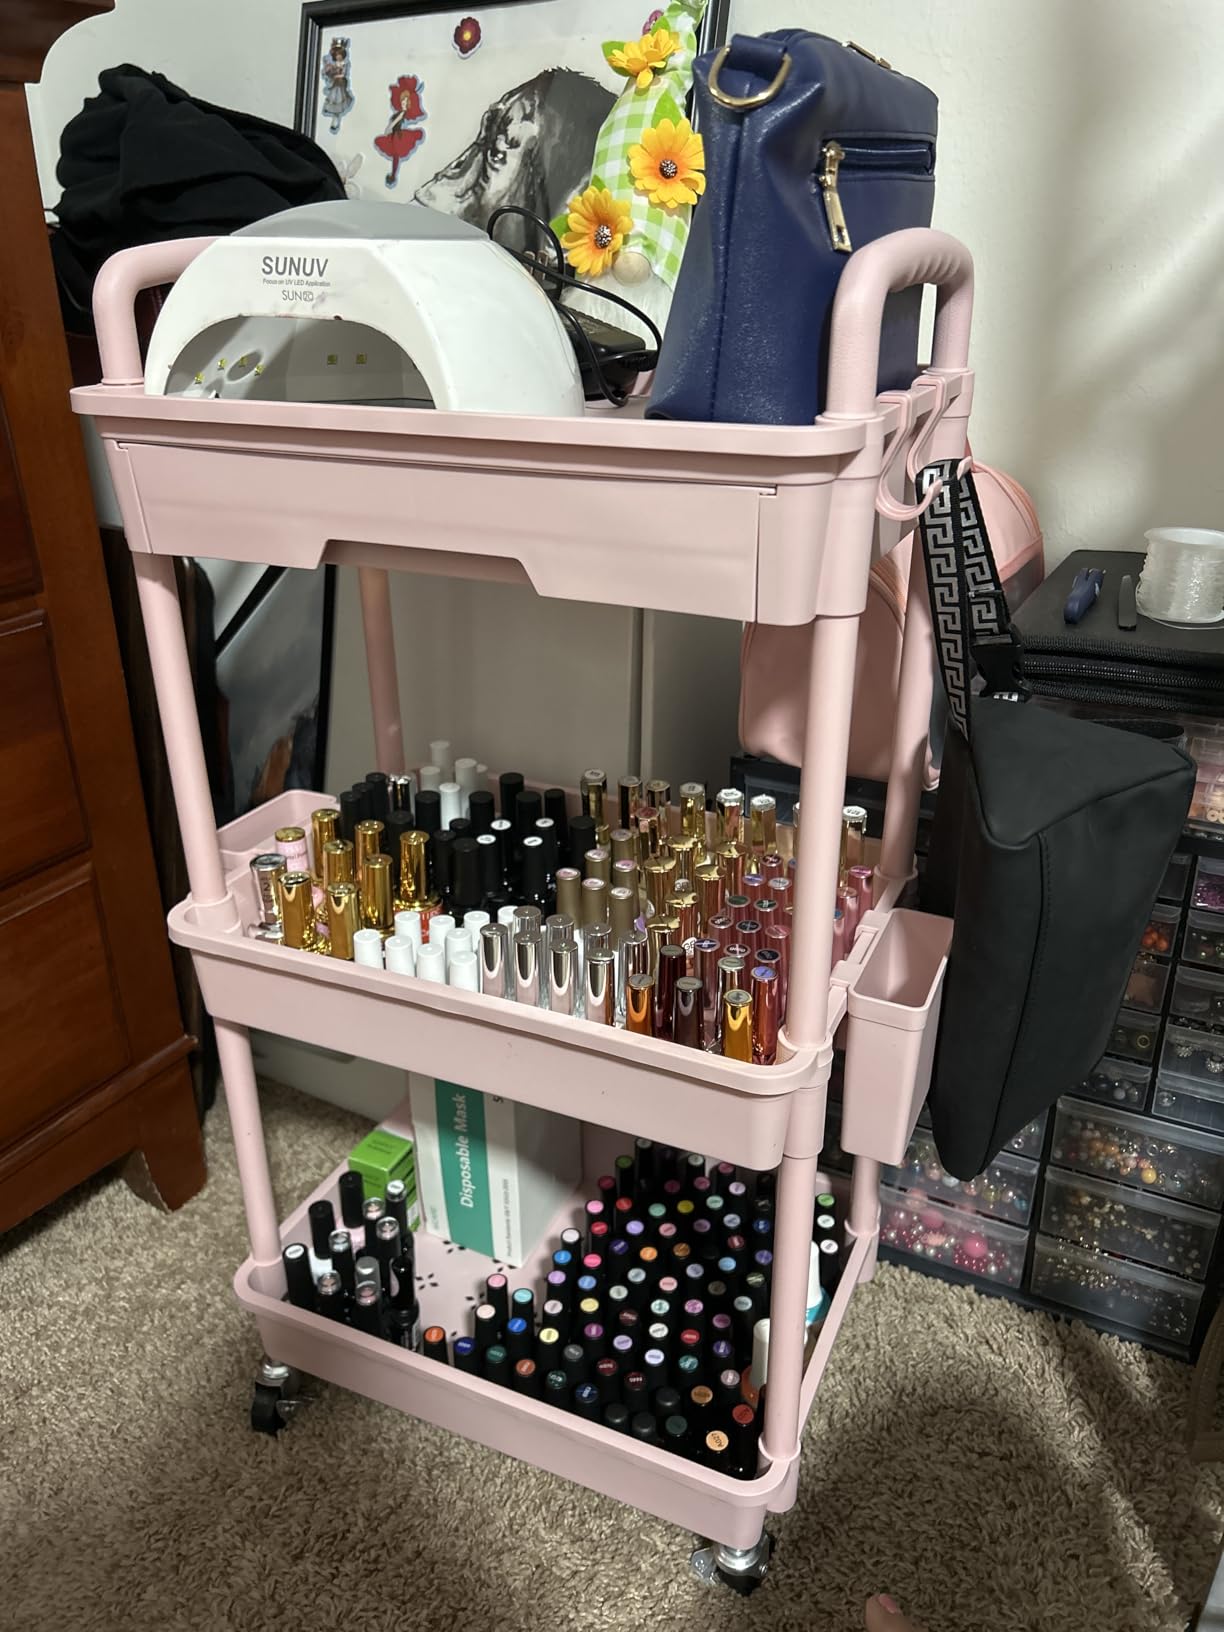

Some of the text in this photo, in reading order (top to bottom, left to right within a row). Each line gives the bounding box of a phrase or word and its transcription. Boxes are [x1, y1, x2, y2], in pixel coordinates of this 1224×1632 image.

[262, 256, 328, 277] SUNUV
[263, 882, 271, 892] 2
[451, 1093, 476, 1208] Disposable Mask
